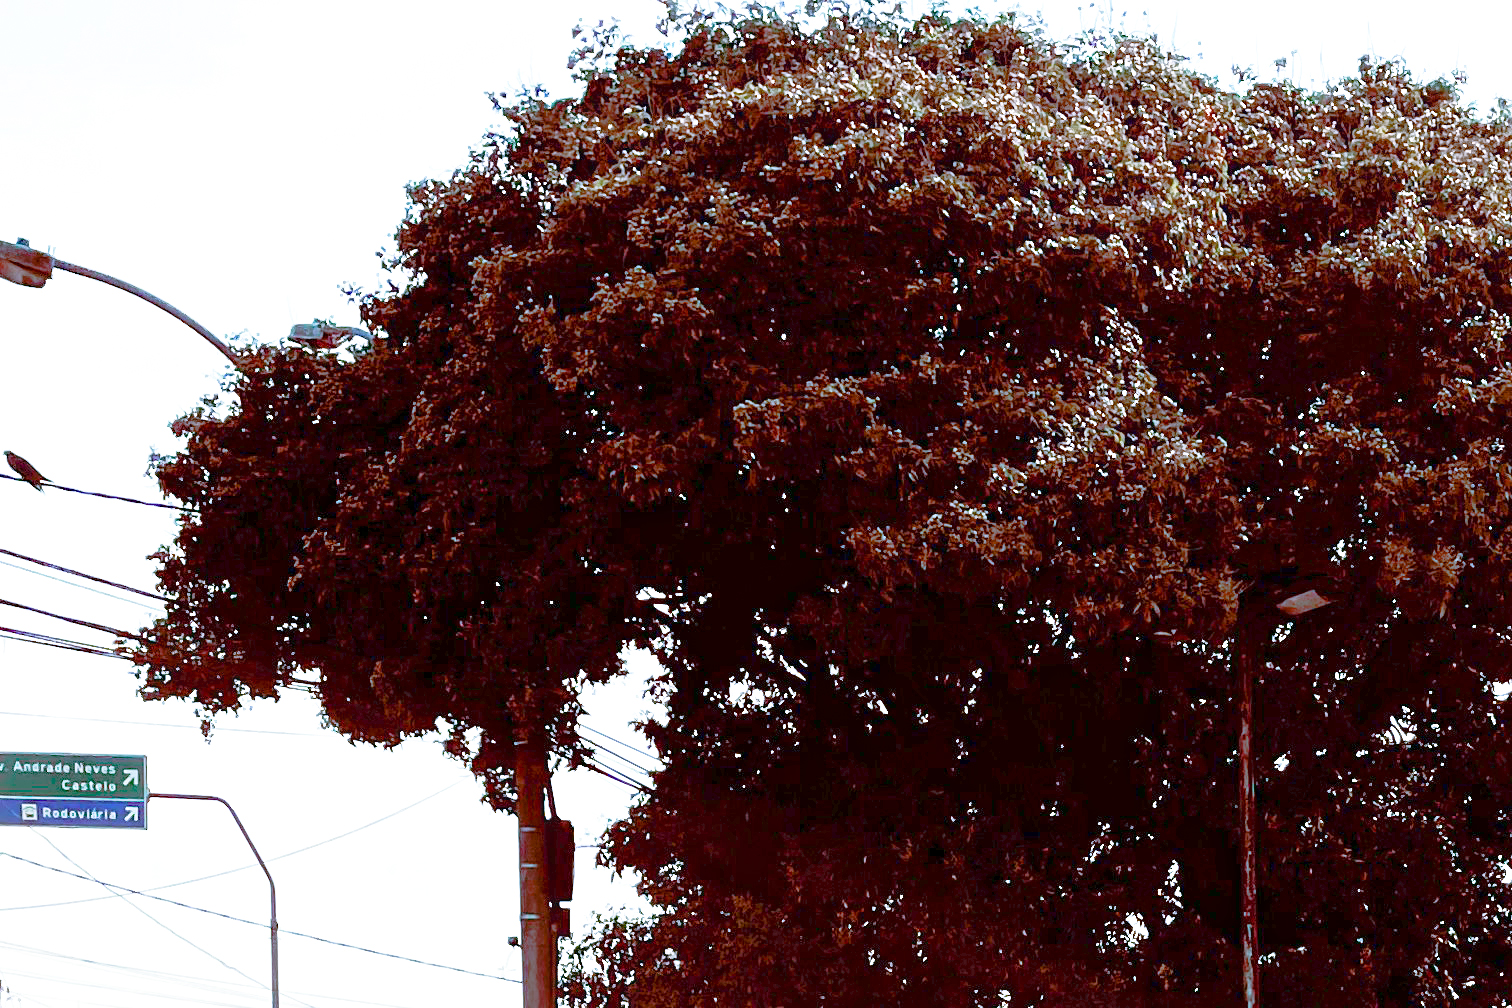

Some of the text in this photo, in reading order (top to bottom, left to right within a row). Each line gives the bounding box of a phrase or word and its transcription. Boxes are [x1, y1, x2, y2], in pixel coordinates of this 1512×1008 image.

[14, 761, 70, 773] Andrade
[75, 762, 116, 775] Neves
[61, 780, 116, 791] Castelo
[42, 807, 117, 820] Rodoviária
